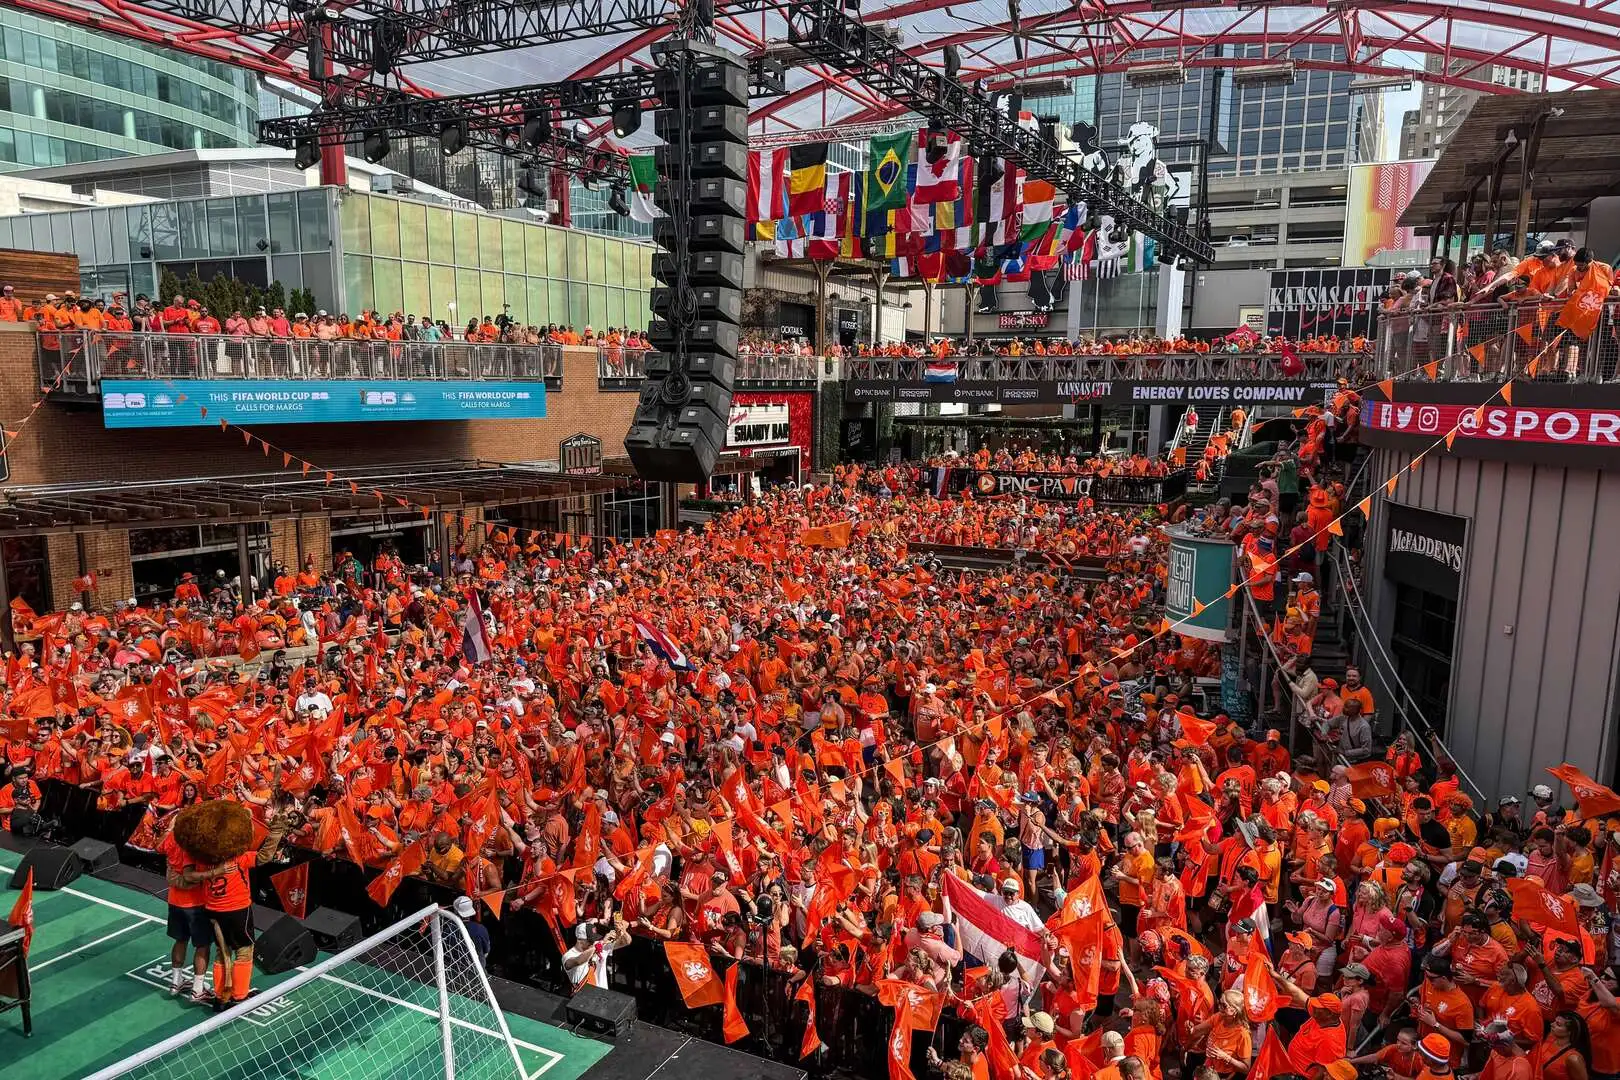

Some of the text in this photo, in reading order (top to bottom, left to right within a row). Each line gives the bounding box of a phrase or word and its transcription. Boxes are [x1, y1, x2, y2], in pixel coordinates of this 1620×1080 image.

[1269, 286, 1339, 313] KANSAS
[1000, 314, 1046, 326] BIG SKY
[962, 389, 975, 397] PNC
[1057, 382, 1113, 396] KANSAS CITY
[1132, 386, 1305, 401] ENERGY LOVES COMPANY
[209, 393, 229, 402] THIS
[232, 392, 254, 401] FIFA
[256, 392, 290, 401] WORLD
[291, 392, 310, 400] CUP
[235, 404, 258, 412] CALLS
[275, 403, 303, 411] MARGS
[734, 423, 770, 443] SHANDY
[564, 446, 601, 468] DIVE
[998, 476, 1092, 495] PNC PAIO
[1390, 528, 1463, 573] McFADDEN'S
